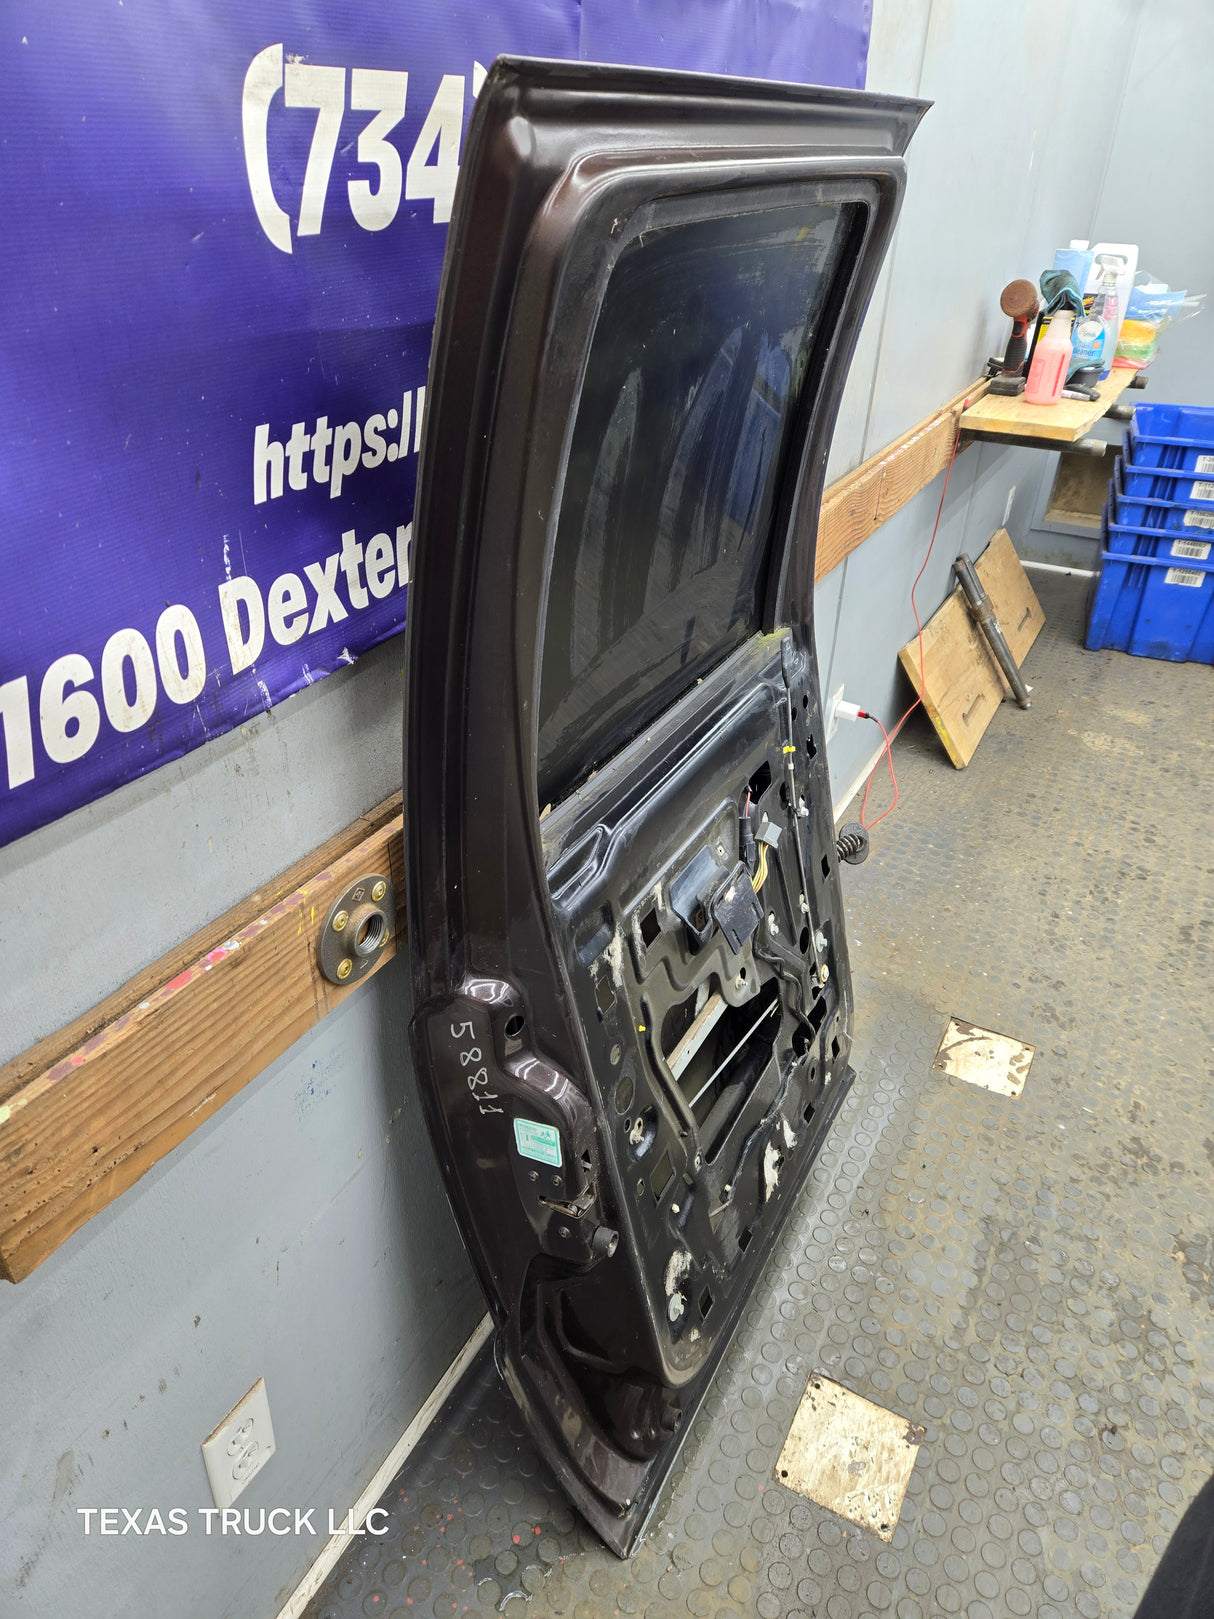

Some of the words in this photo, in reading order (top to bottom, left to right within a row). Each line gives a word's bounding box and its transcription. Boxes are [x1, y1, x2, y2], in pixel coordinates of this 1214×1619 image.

[242, 43, 488, 254] (734
[254, 386, 426, 505] https://
[0, 603, 207, 790] 1600
[450, 1021, 504, 1115] 58811
